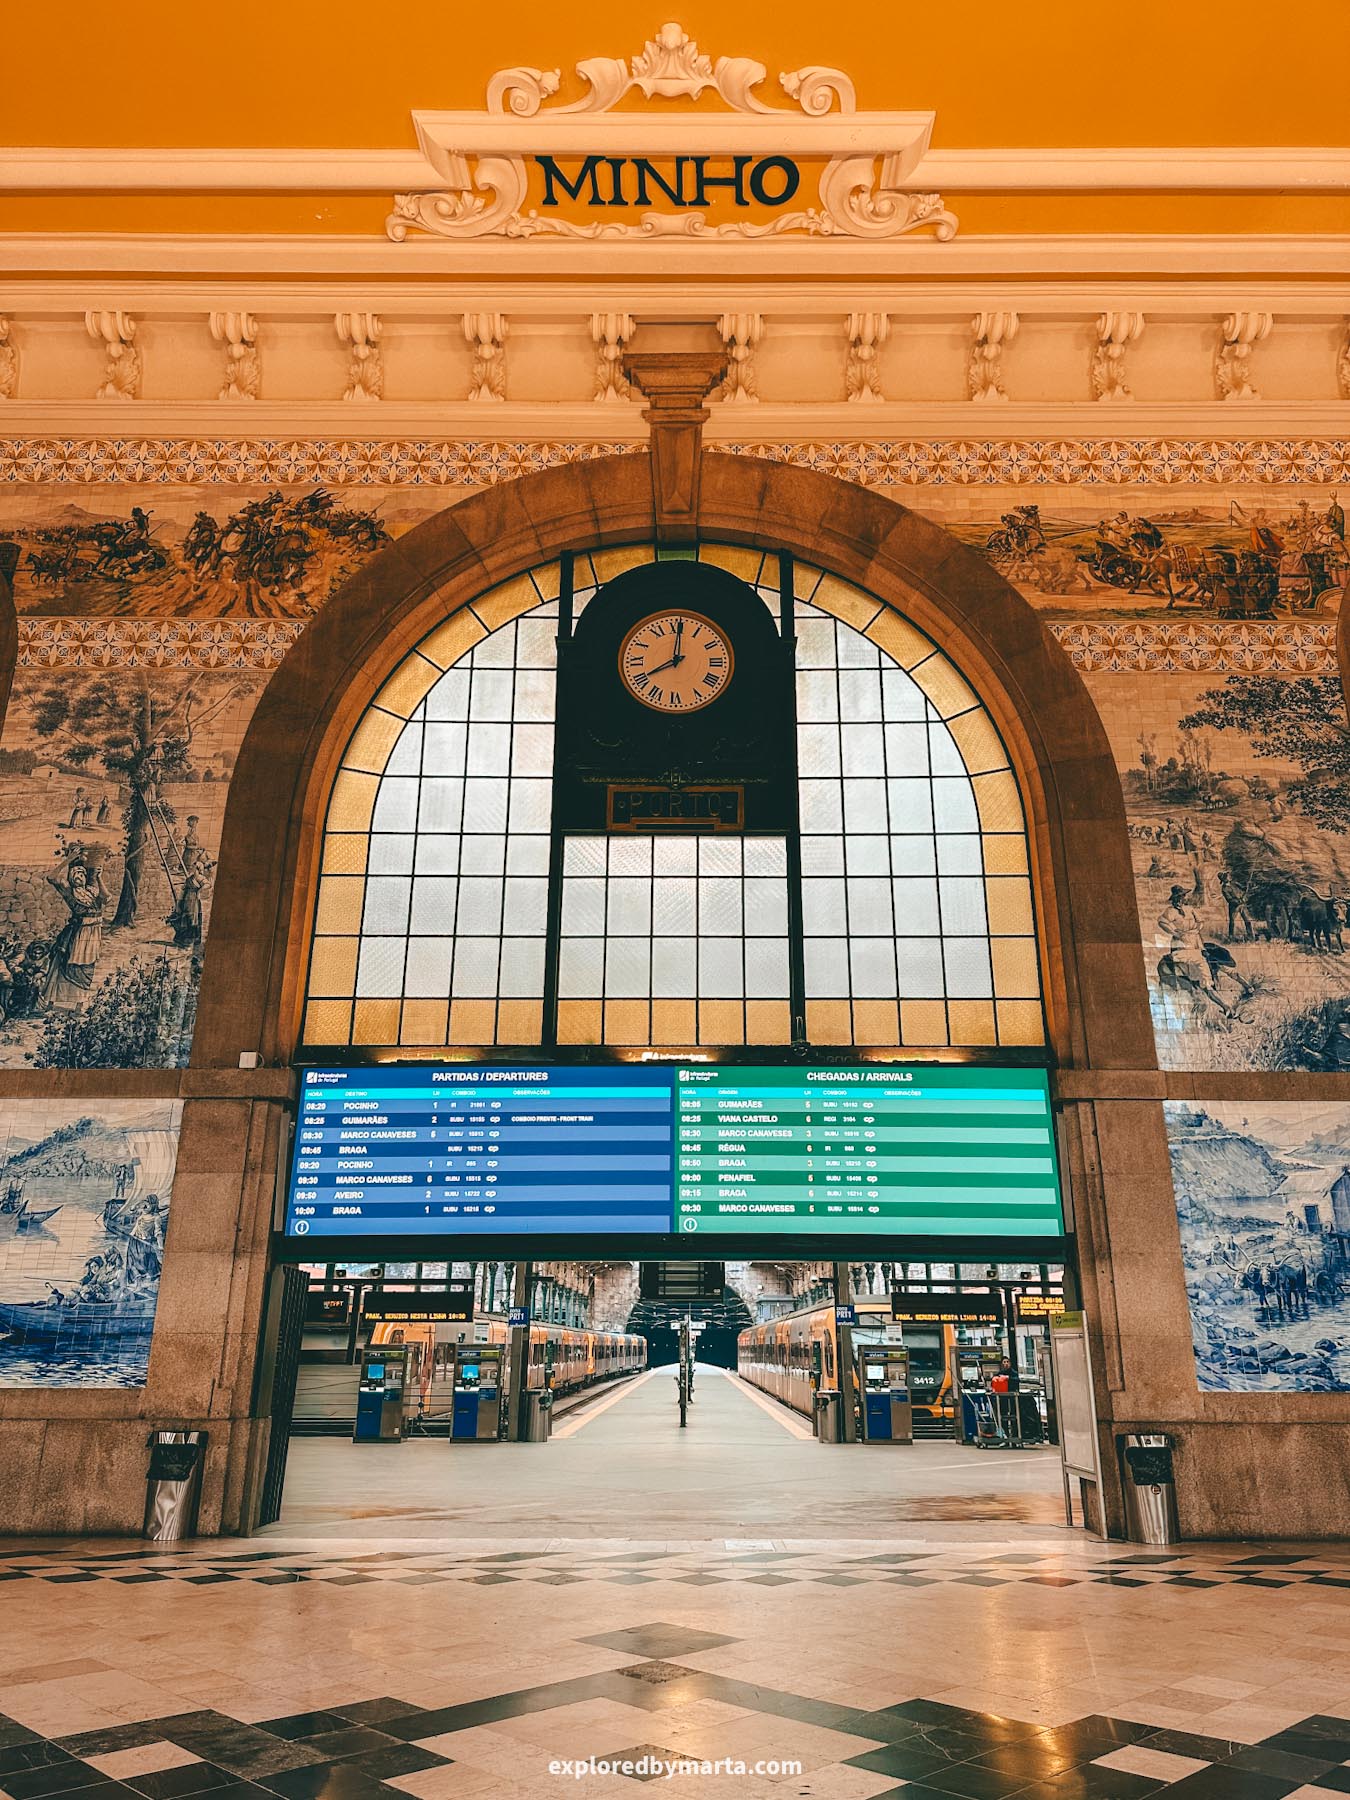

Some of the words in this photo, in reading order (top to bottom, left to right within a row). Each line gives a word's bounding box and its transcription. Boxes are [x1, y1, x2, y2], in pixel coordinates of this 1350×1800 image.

[534, 155, 800, 207] MINHO
[649, 623, 666, 639] XI
[692, 626, 702, 639] I
[634, 640, 649, 651] X
[704, 640, 719, 650] II
[630, 655, 644, 667] IX
[709, 657, 723, 667] III
[633, 671, 650, 690] VIII
[702, 672, 720, 688] IIII
[648, 685, 664, 702] VII
[670, 690, 681, 704] VI
[692, 687, 703, 701] V
[630, 792, 721, 817] PORTO
[432, 1073, 479, 1081] PARTIDAS
[480, 1073, 485, 1081] /
[486, 1072, 549, 1081] DEPARTURES
[807, 1072, 859, 1081] CHEGADAS
[860, 1073, 865, 1081] /
[866, 1073, 913, 1081] ARRIVALS
[343, 1102, 379, 1110] POCINHO
[718, 1099, 763, 1108] GUIMARÃES
[304, 1117, 325, 1125] 08:25
[342, 1115, 388, 1125] GUIMARÃES
[718, 1115, 741, 1123] VIANA
[742, 1115, 778, 1123] CASTELO
[340, 1131, 369, 1139] MARCO
[370, 1131, 417, 1139] CANAVESES
[339, 1146, 367, 1154] BRAGA
[718, 1143, 746, 1152] RÉGUA
[806, 1144, 813, 1152] 6
[337, 1161, 373, 1169] POCINHO
[428, 1160, 433, 1168] 1
[718, 1159, 746, 1167] BRAGA
[298, 1176, 318, 1184] 09:30
[336, 1176, 365, 1184] MARCO
[366, 1175, 413, 1184] CANAVESES
[718, 1174, 756, 1182] PENAFIEL
[334, 1191, 363, 1199] AVEIRO
[681, 1189, 701, 1197] 09:15
[719, 1189, 747, 1197] BRAGA
[294, 1207, 315, 1215] 10:00
[424, 1206, 430, 1214] 1
[681, 1204, 701, 1212] 09:30
[719, 1204, 747, 1212] MARCO
[748, 1204, 796, 1212] CANAVESES
[510, 1312, 525, 1320] PRT1
[836, 1310, 852, 1318] PRT1
[914, 1377, 935, 1385] 3412
